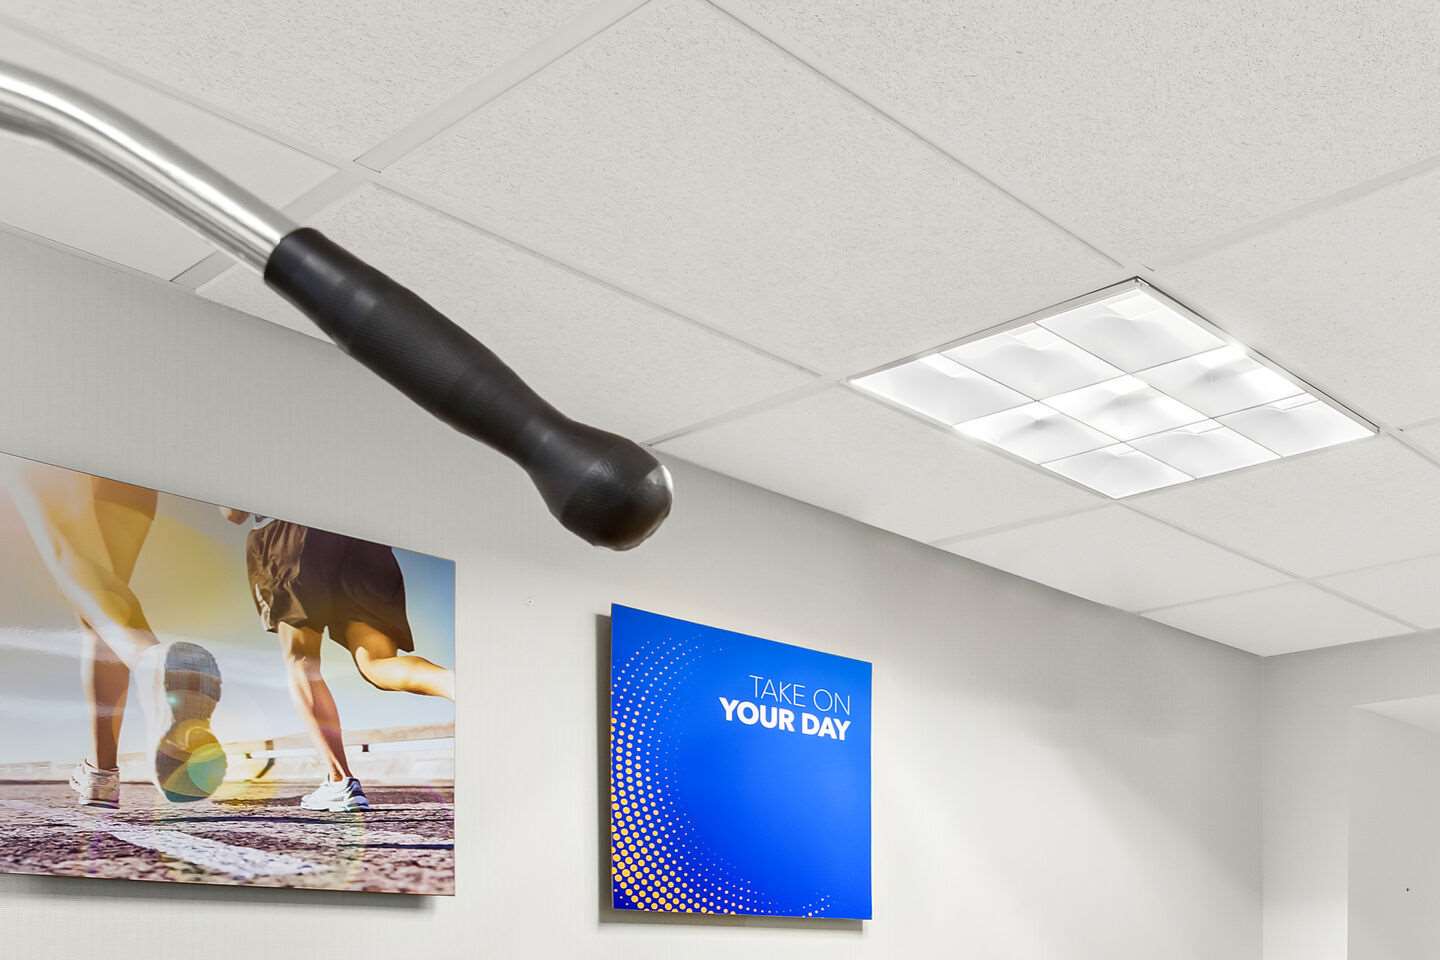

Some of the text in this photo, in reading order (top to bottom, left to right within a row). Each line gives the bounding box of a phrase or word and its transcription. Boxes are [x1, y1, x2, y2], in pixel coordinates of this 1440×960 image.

[748, 674, 850, 716] TAKE ON
[719, 696, 851, 741] YOUR DAY
